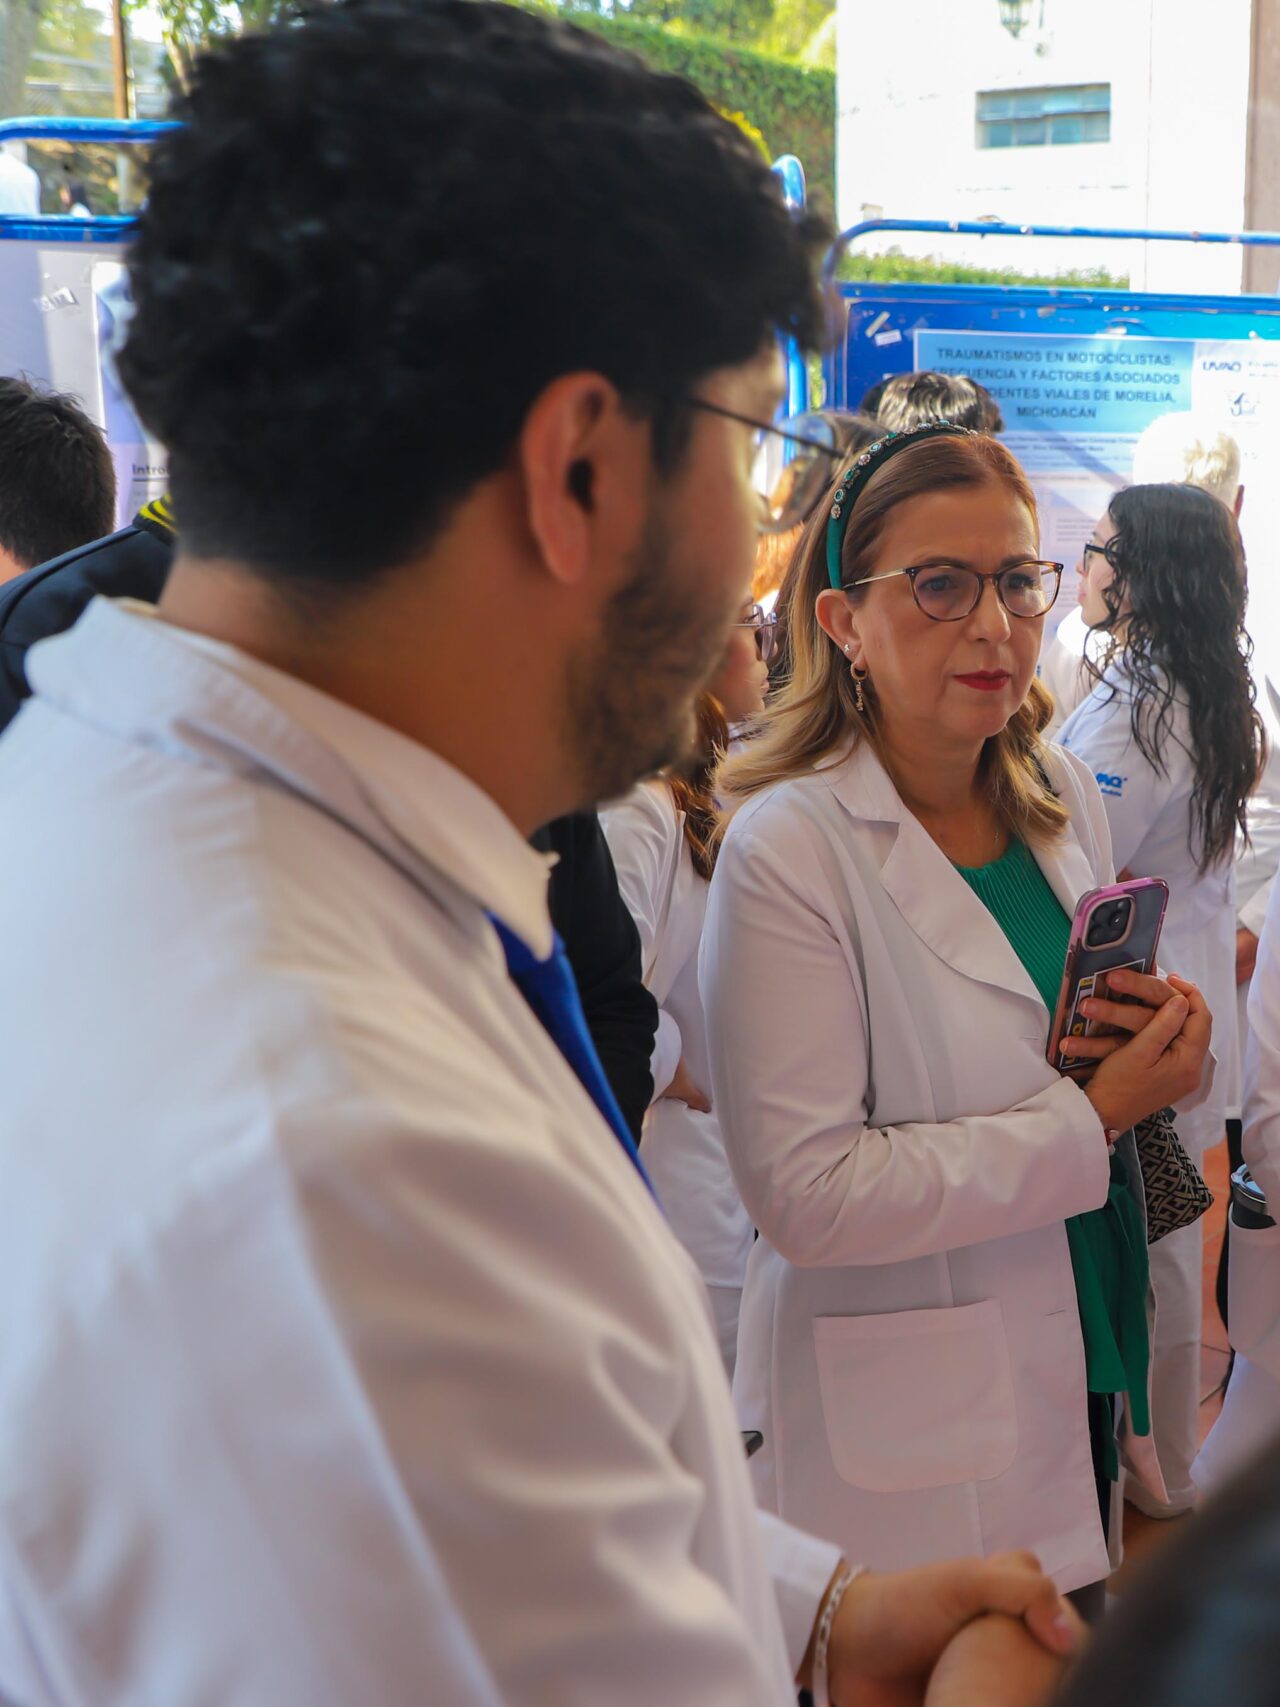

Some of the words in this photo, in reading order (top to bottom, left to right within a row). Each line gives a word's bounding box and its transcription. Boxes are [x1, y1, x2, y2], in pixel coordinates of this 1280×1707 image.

[937, 348, 1041, 362] TRAUMATISMOS
[1046, 352, 1064, 362] EN
[1018, 369, 1027, 381] Y
[1031, 370, 1101, 382] FACTORES
[1103, 371, 1181, 385] ASOCIADOS
[1044, 388, 1091, 401] VIALES
[1094, 389, 1112, 401] DE
[131, 463, 168, 477] Intro
